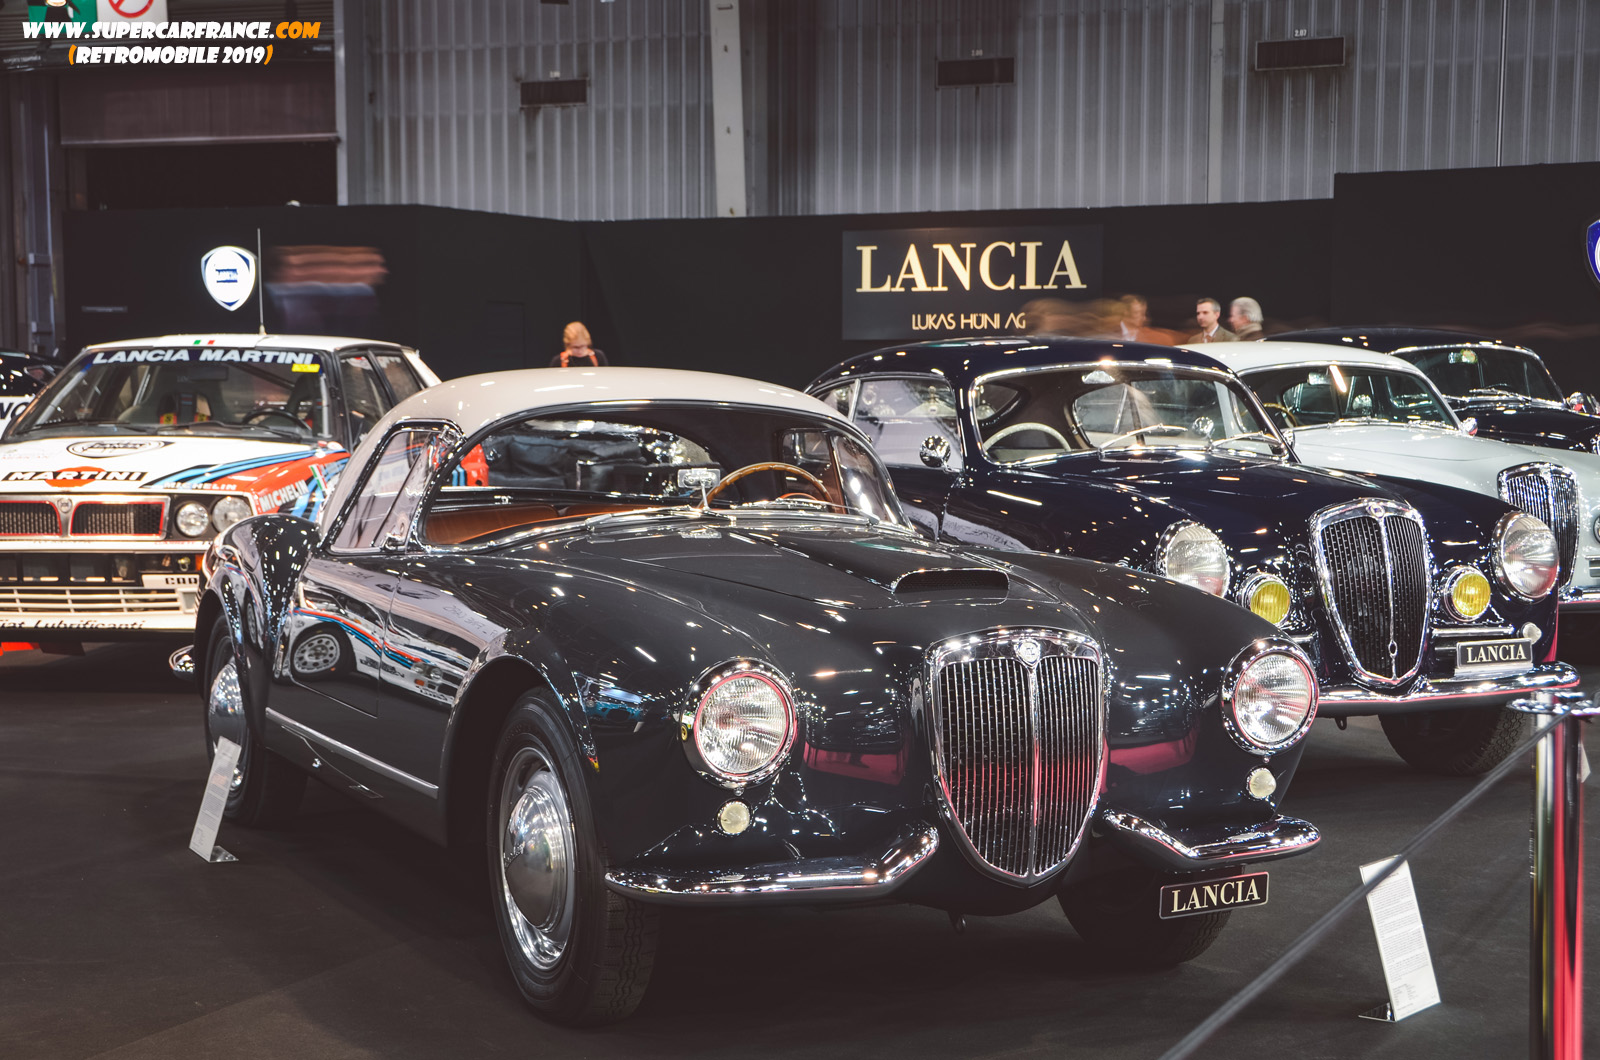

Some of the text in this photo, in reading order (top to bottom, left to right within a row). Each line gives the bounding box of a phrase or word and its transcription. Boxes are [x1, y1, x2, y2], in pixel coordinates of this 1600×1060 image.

[856, 240, 1087, 292] LANCIA
[912, 312, 1026, 330] LUKAS HÜNI AG
[92, 349, 314, 365] LANCIA MARTINI
[8, 471, 142, 481] MARTINI
[162, 481, 238, 491] MICHELIN
[258, 479, 310, 513] MICHELIN
[33, 620, 146, 630] Lubrificanti
[1467, 644, 1527, 663] LANCIA
[1171, 878, 1261, 913] LANCIA
